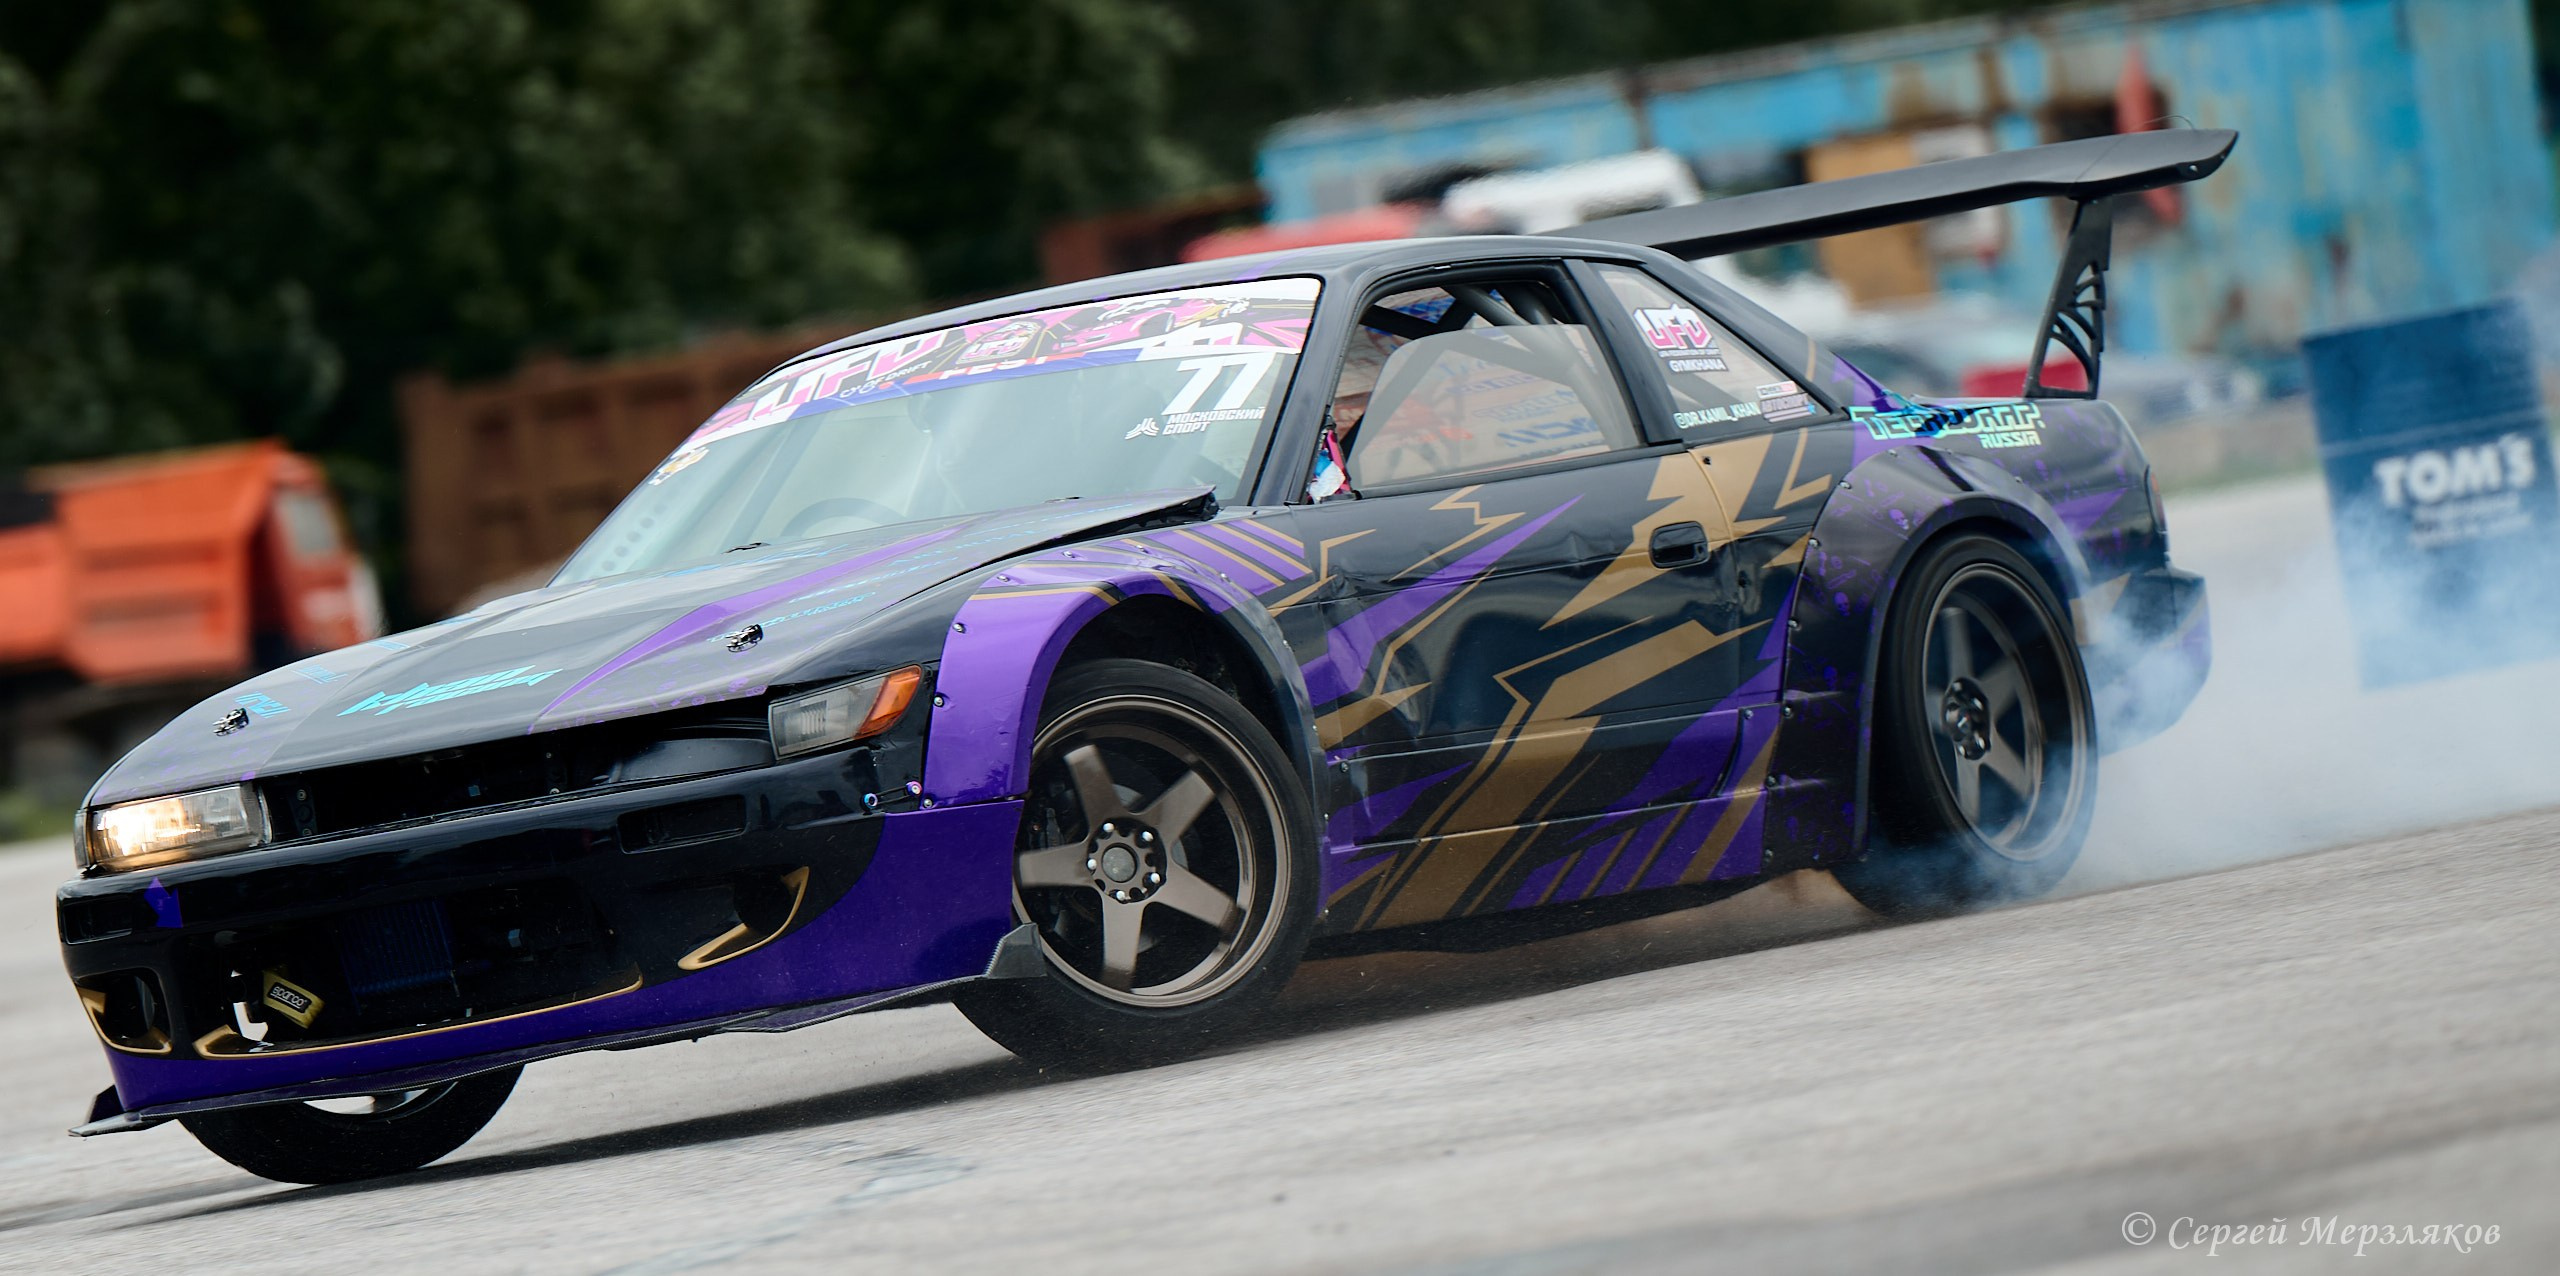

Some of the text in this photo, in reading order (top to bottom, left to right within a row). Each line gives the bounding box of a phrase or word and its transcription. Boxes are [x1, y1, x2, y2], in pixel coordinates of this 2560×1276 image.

[1633, 305, 1712, 349] UFD
[1669, 358, 1726, 372] GYMKHANA
[1161, 352, 1278, 415] 77
[1167, 406, 1265, 425] МОСКОВСКИЙ
[1163, 422, 1210, 435] СПОРТ
[1978, 430, 2042, 448] RUSSIA
[2373, 433, 2535, 508] TOM'S
[272, 986, 305, 1007] sparco
